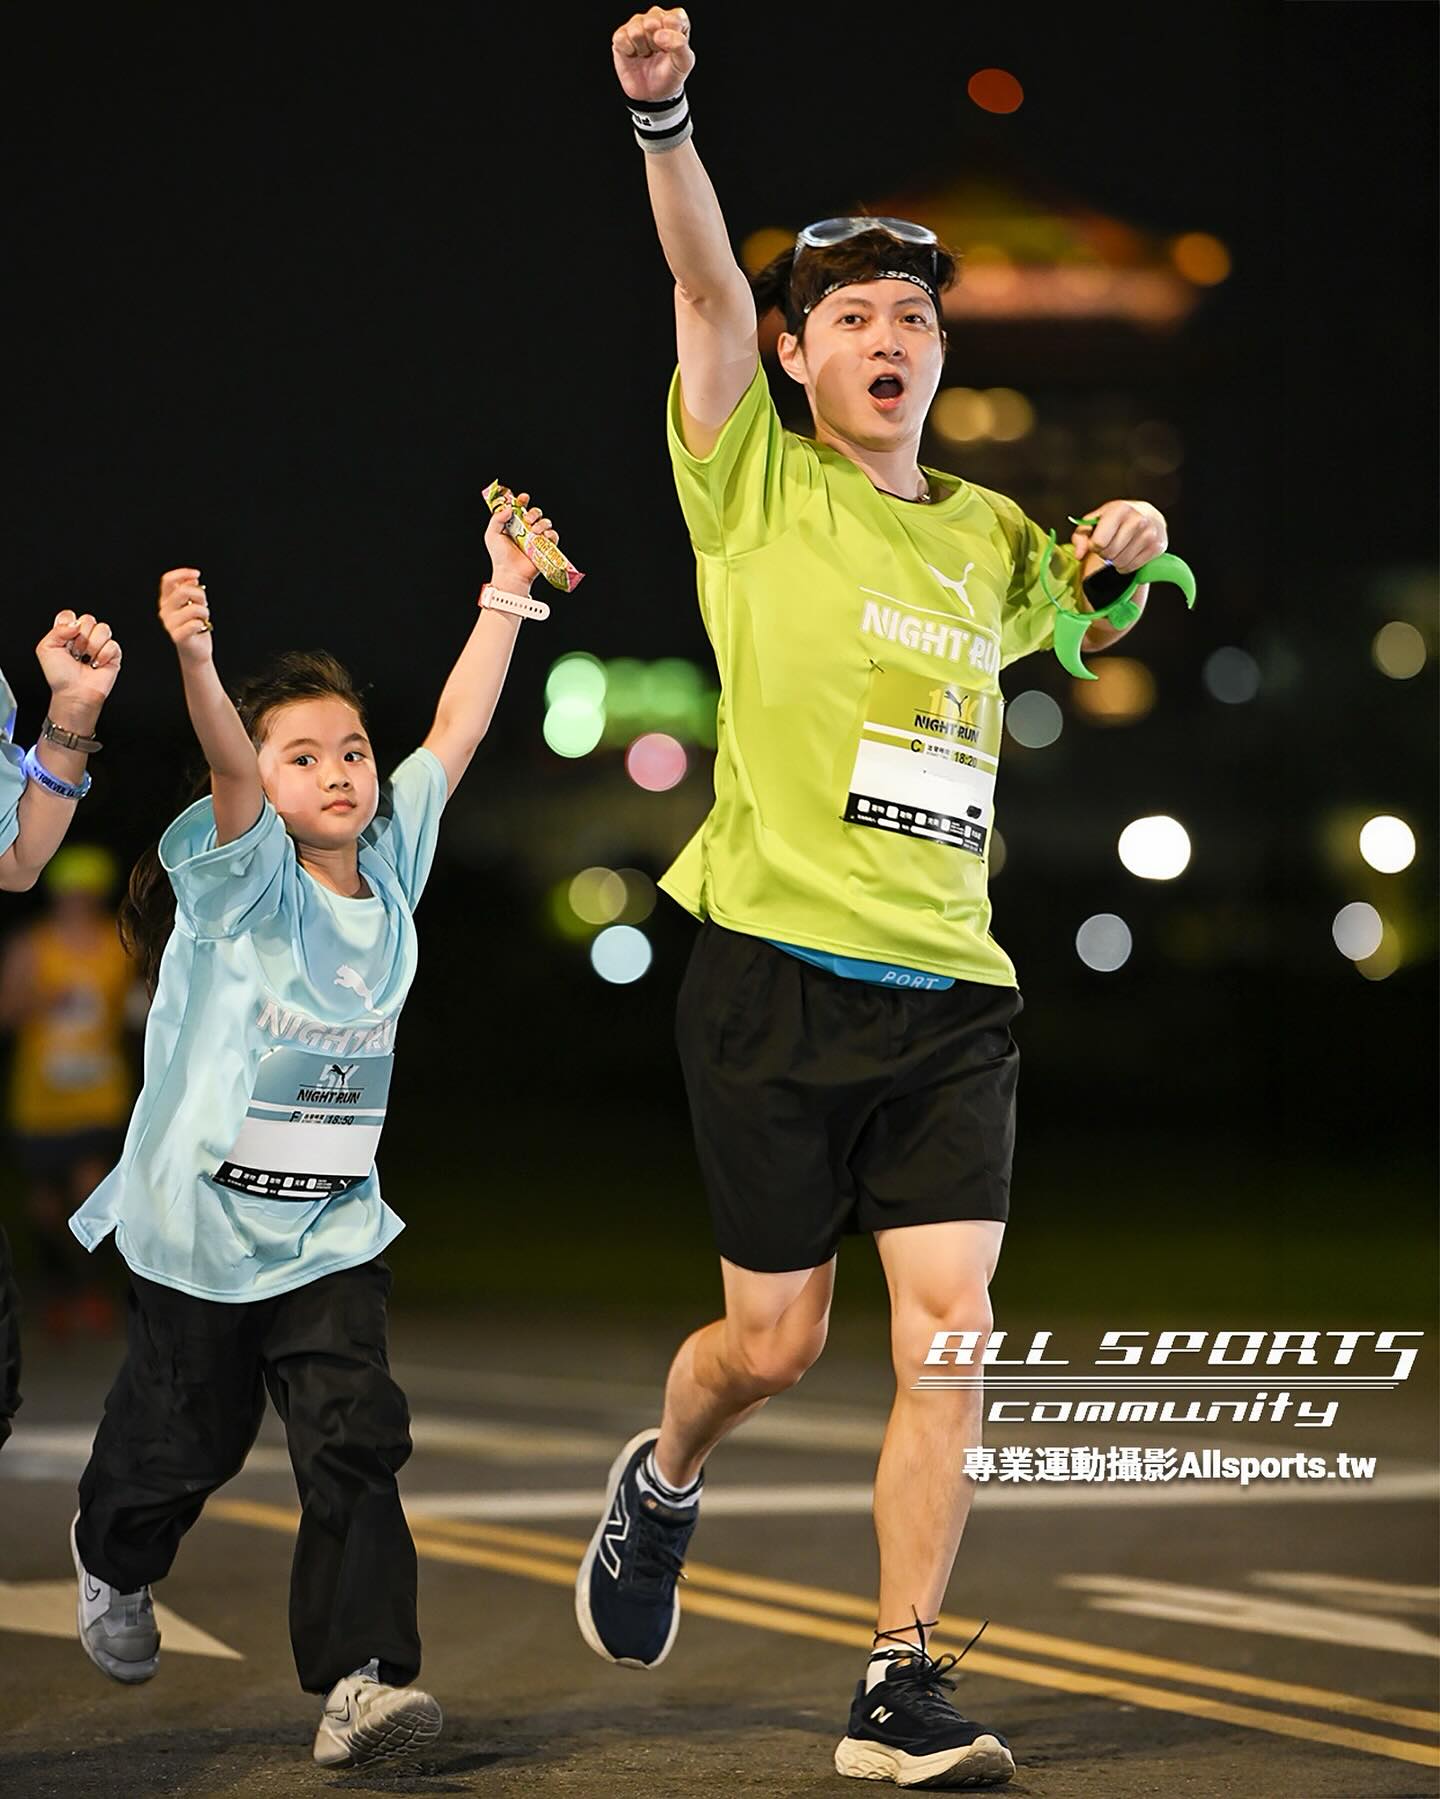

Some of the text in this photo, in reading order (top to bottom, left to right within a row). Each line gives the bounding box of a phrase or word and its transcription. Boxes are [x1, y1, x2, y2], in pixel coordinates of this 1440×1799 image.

[861, 600, 998, 675] NIGHT RU
[914, 714, 980, 743] NIGHT RUN
[911, 739, 922, 752] C
[954, 751, 977, 768] 18:20
[880, 971, 939, 990] PORT
[327, 1114, 354, 1125] 18:50
